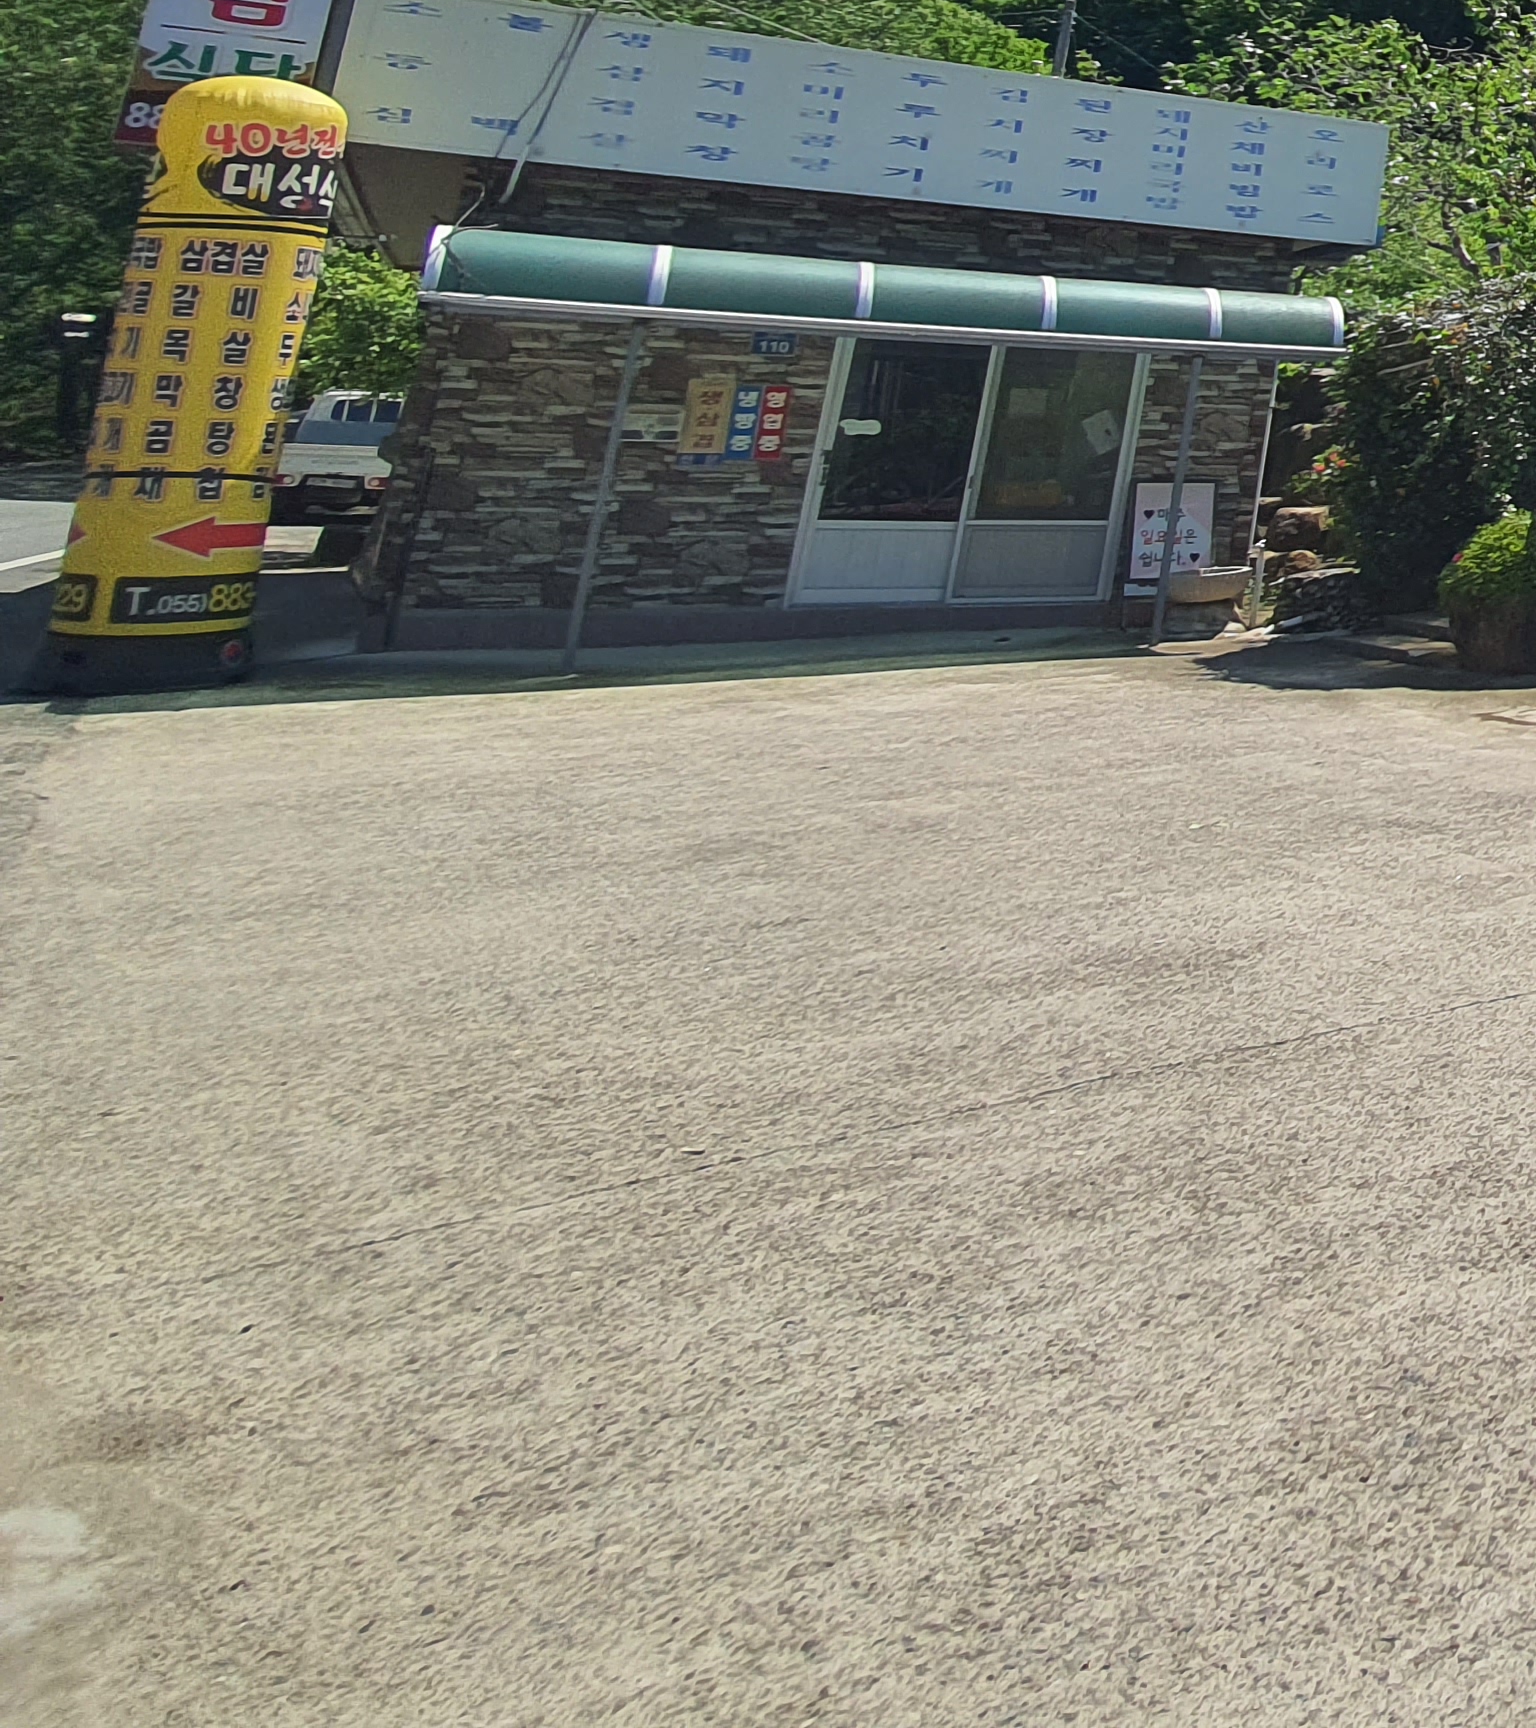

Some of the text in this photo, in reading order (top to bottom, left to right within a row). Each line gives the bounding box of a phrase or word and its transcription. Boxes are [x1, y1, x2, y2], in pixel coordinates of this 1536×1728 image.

[180, 238, 269, 277] 삼겹살
[758, 340, 790, 354] 110
[757, 390, 788, 453] 영업중
